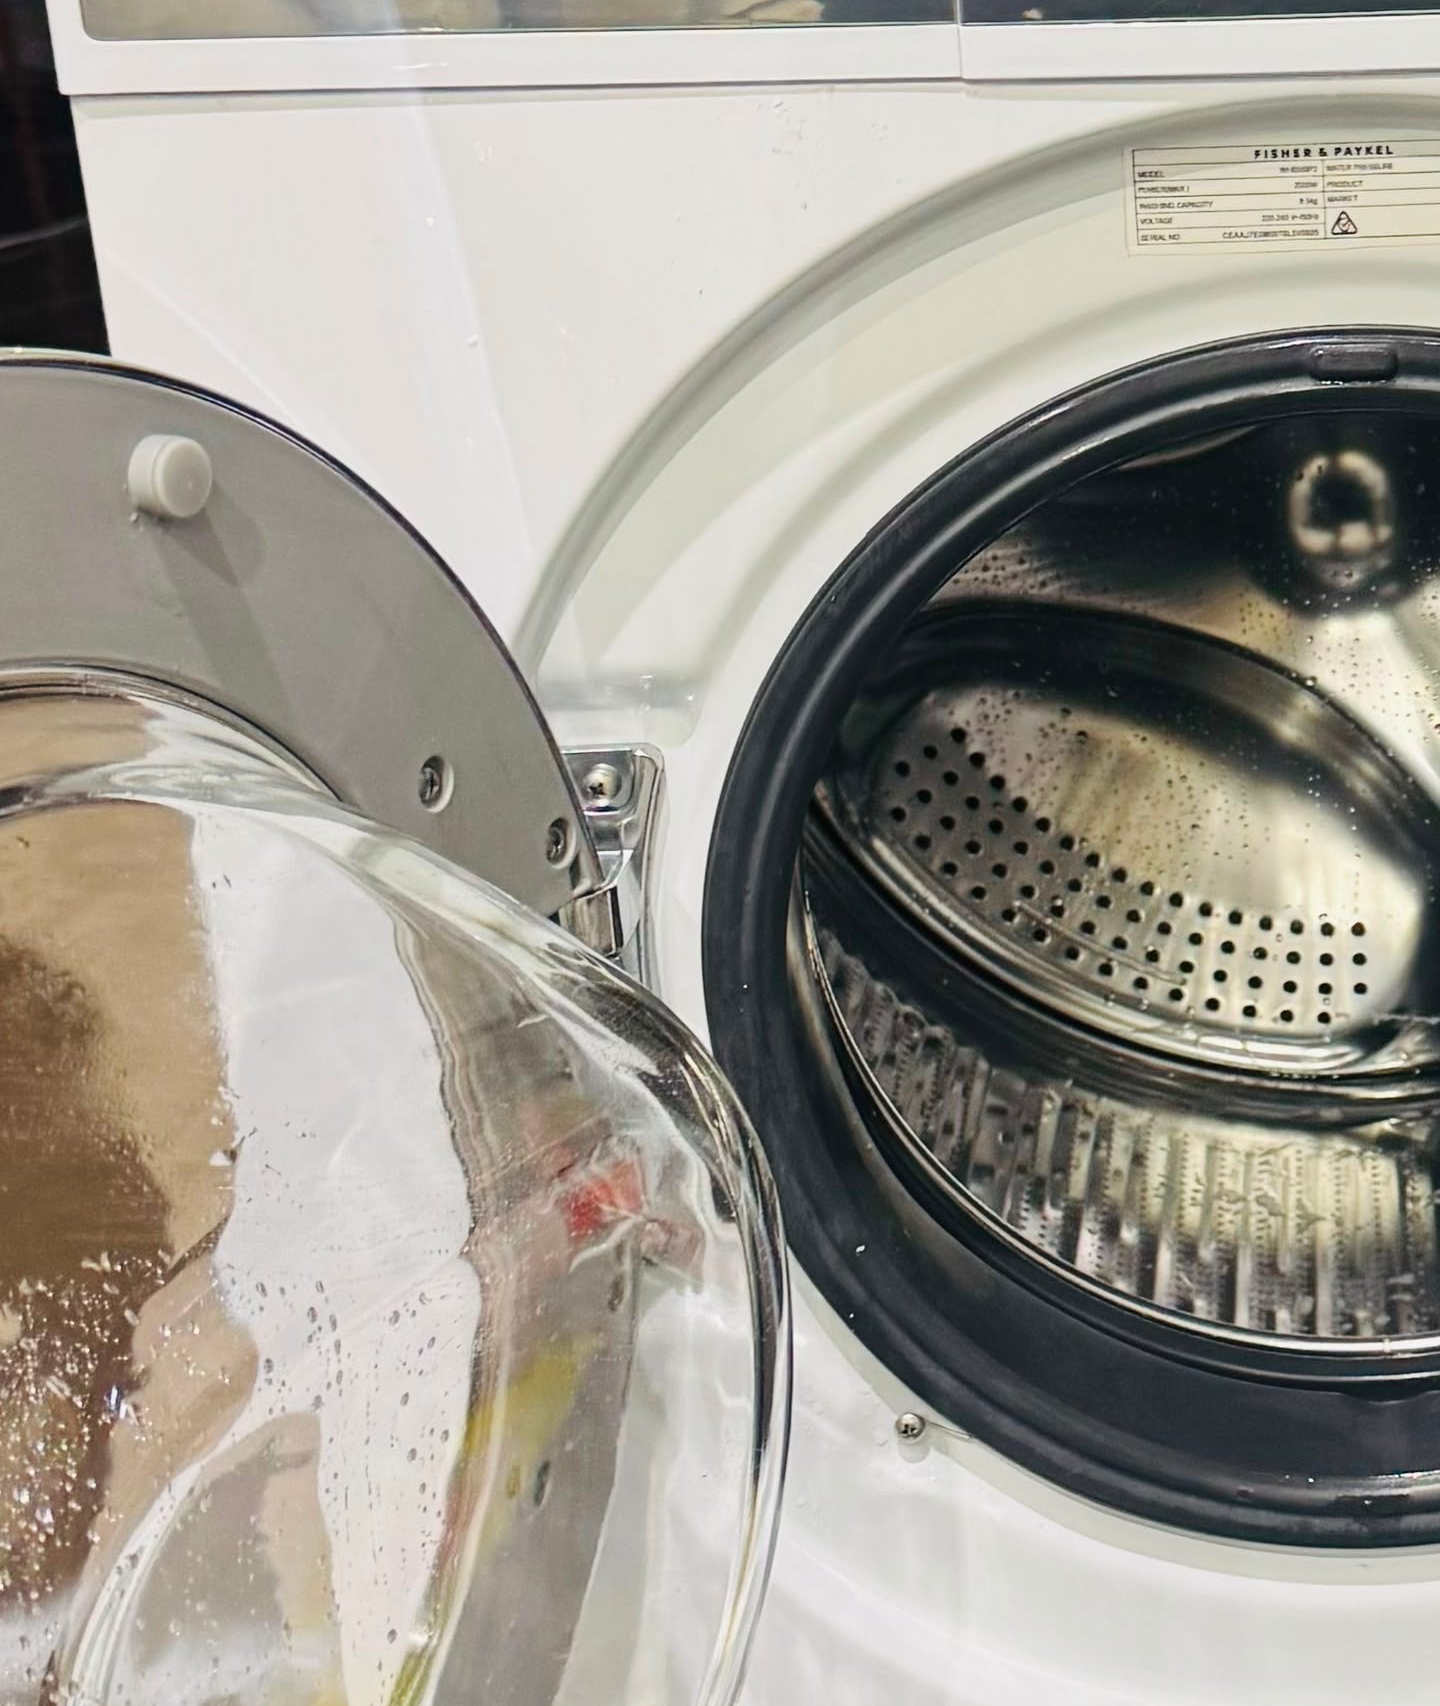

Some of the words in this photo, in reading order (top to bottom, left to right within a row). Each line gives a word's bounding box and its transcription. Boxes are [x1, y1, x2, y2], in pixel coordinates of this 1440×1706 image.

[1255, 149, 1311, 159] FISHER
[1319, 148, 1327, 157] &
[1335, 146, 1393, 156] PAYKEL
